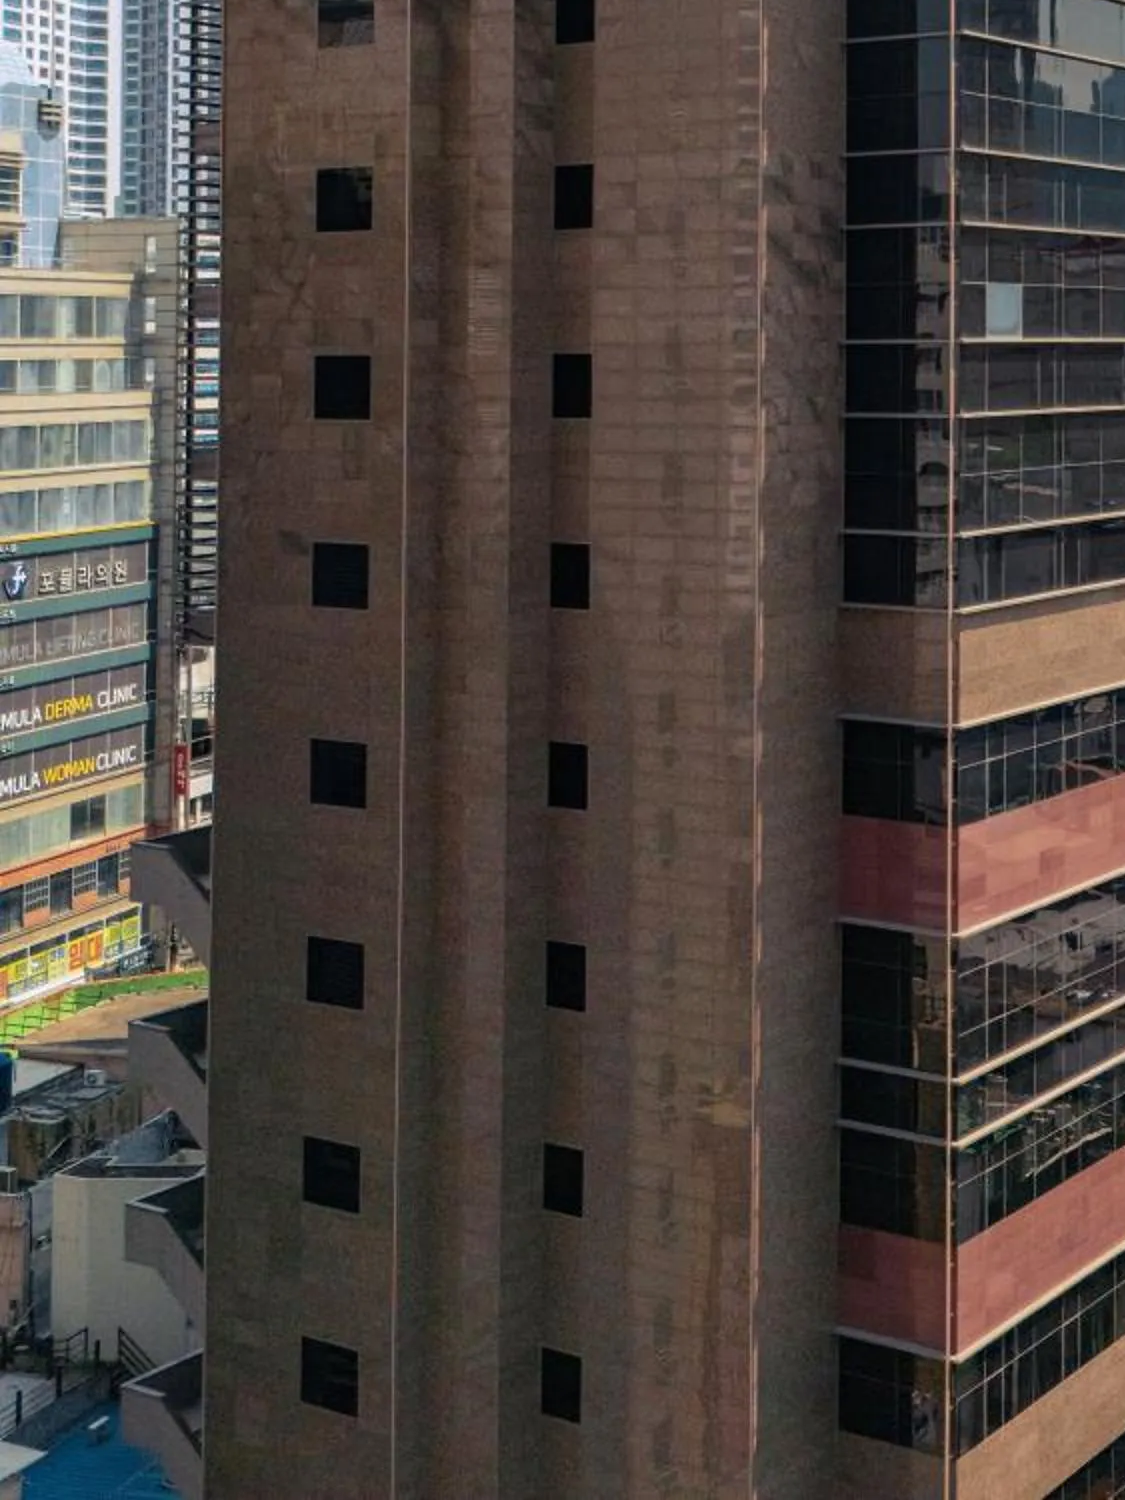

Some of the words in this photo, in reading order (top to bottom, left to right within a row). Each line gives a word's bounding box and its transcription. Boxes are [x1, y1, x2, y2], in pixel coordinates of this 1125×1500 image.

[45, 693, 93, 721] DERMA
[97, 683, 138, 708] CLINIC
[43, 756, 96, 784] WOMAN
[96, 745, 138, 771] CLINIC
